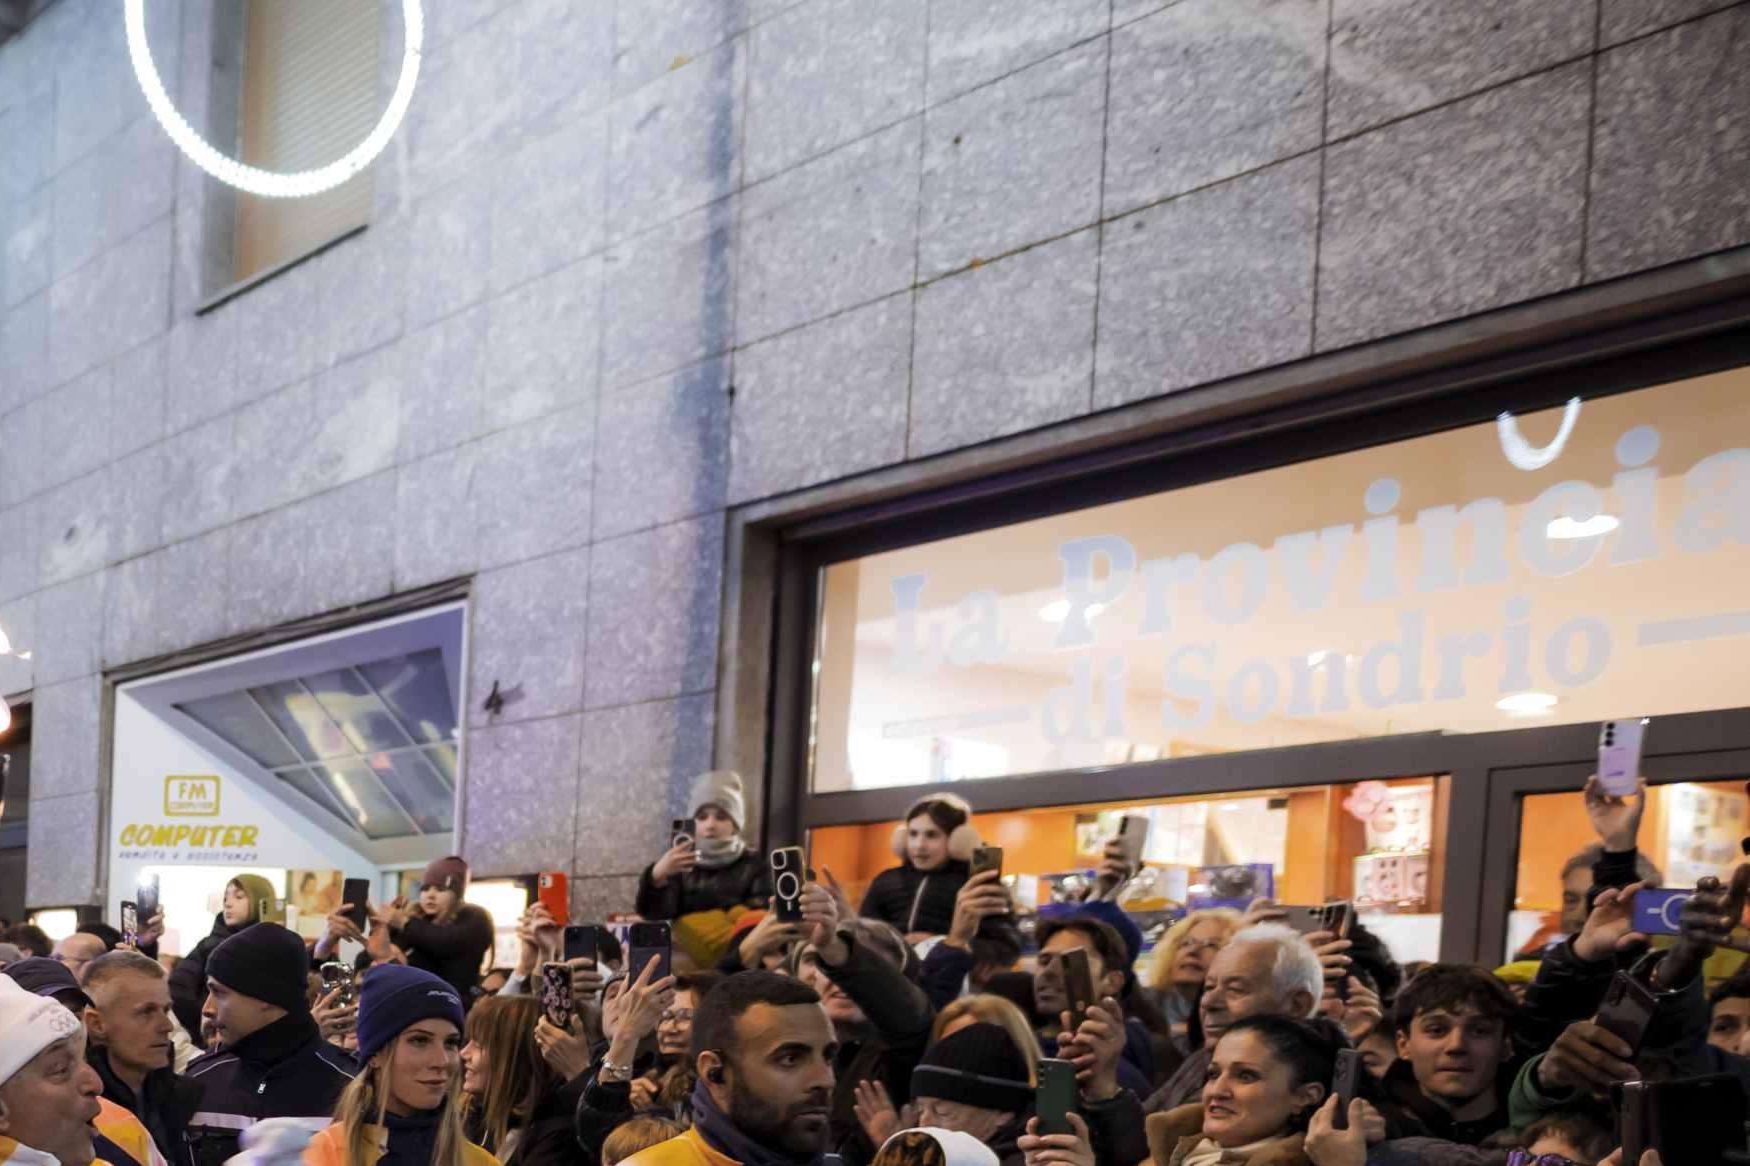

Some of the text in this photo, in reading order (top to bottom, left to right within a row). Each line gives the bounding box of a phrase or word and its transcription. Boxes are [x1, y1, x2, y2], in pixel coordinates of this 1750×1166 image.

[887, 424, 1750, 677] La Provincia
[1040, 594, 1613, 745] di Sondrio
[178, 782, 207, 800] FM
[119, 823, 259, 848] COMPUTER
